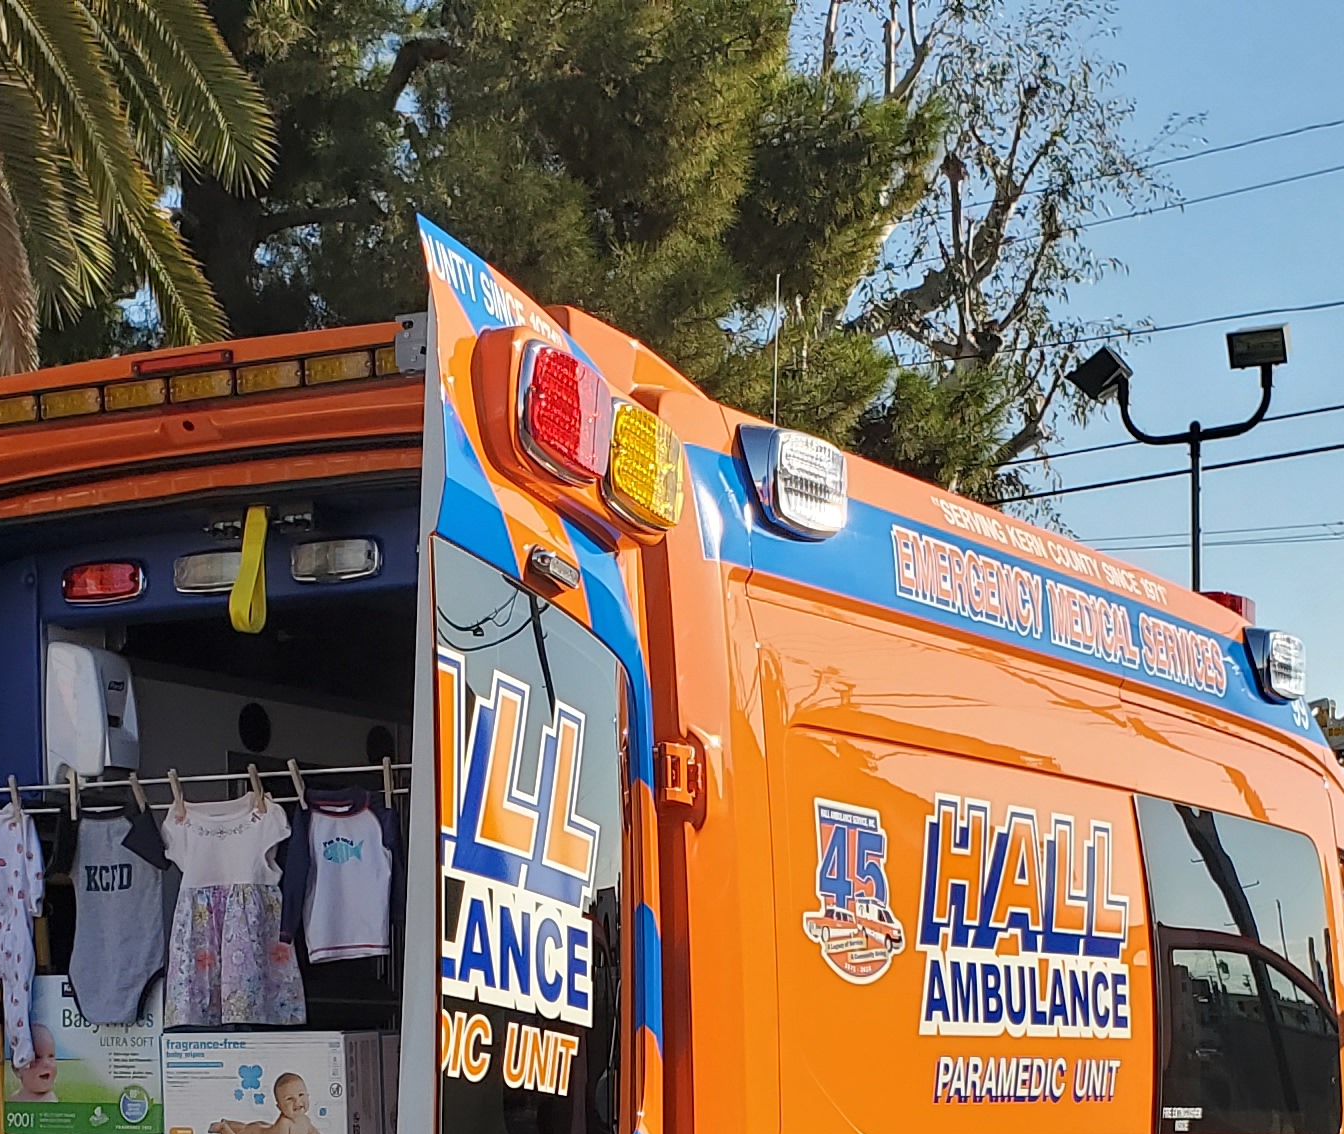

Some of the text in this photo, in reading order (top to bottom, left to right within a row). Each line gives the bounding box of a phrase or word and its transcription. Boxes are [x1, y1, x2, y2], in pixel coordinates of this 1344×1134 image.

[480, 270, 526, 328] SINCE
[1006, 524, 1048, 559] KERN
[1047, 541, 1102, 580] COUNTY
[1101, 562, 1143, 596] SINCE
[891, 524, 1228, 698] EMERGENCY MEDICAL SERVICES
[819, 824, 887, 910] 45
[916, 792, 1130, 959] HALL
[923, 959, 1129, 1034] AMBULANCE
[100, 1037, 154, 1047] ULTRA SOFT
[166, 1039, 246, 1051] fragrance-free
[503, 1021, 578, 1096] UNIT
[934, 1056, 1121, 1105] PARAMEDIC UNIT
[7, 1112, 30, 1128] 900
